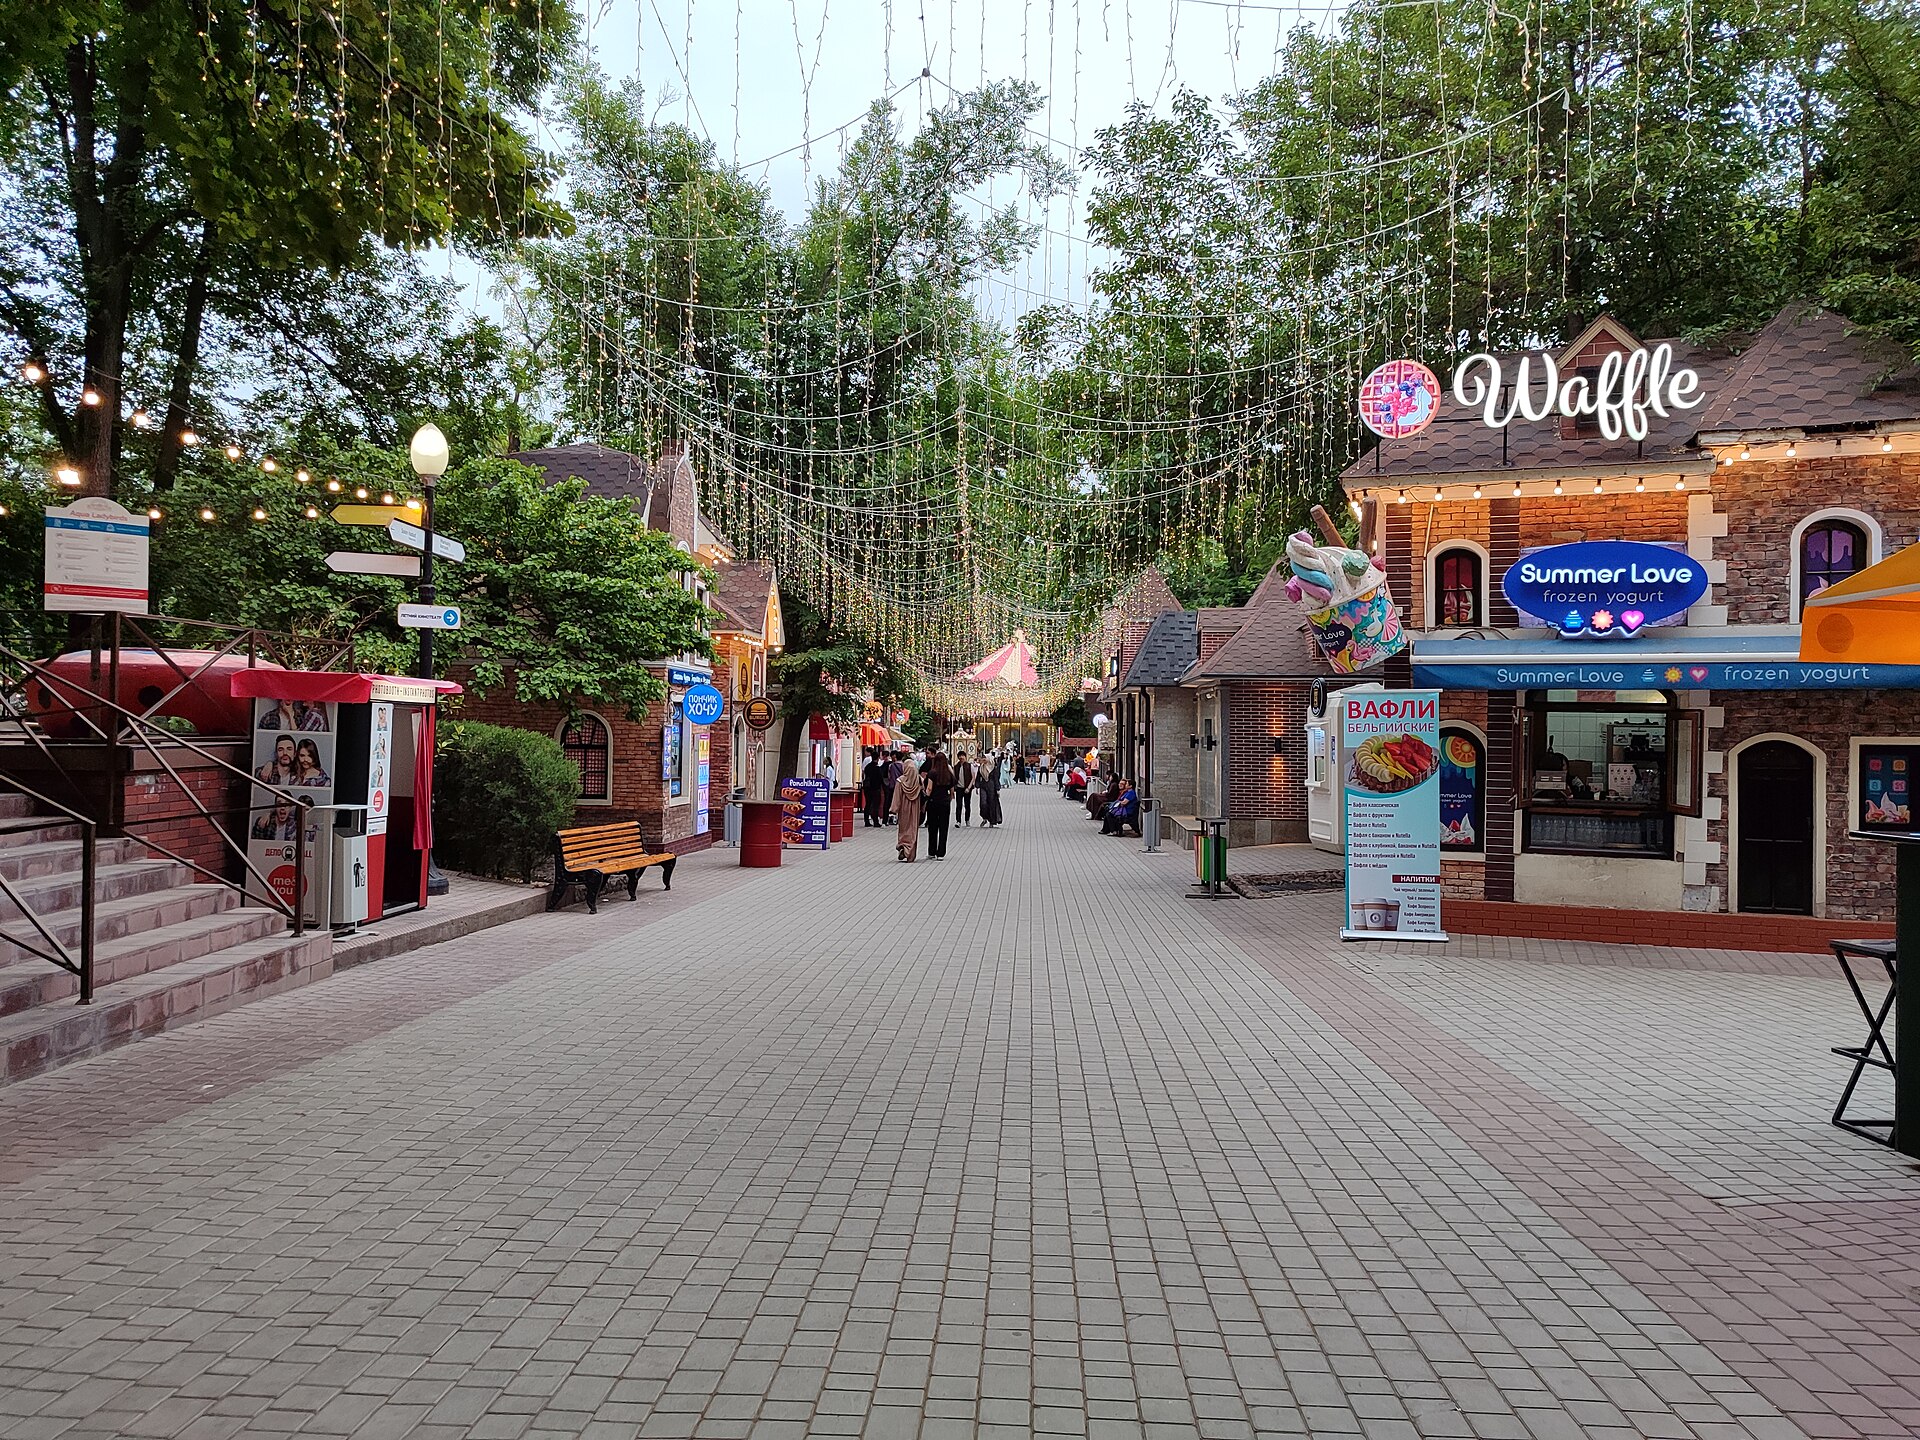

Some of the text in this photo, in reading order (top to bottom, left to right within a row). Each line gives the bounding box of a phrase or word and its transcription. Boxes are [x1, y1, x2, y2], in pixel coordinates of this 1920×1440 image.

[1453, 343, 1705, 441] Waffle
[1520, 563, 1692, 584] Summer Love
[1543, 590, 1664, 605] frozen yogurt
[1322, 630, 1345, 640] Love
[1497, 666, 1870, 683] Summer Love frozen yogurt
[688, 694, 717, 703] ПОНЧИК
[688, 703, 717, 715] ХОЧУ
[1348, 700, 1434, 719] ВАФЛИ
[1348, 721, 1434, 732] БЕЛЬГИЙСКИЕ
